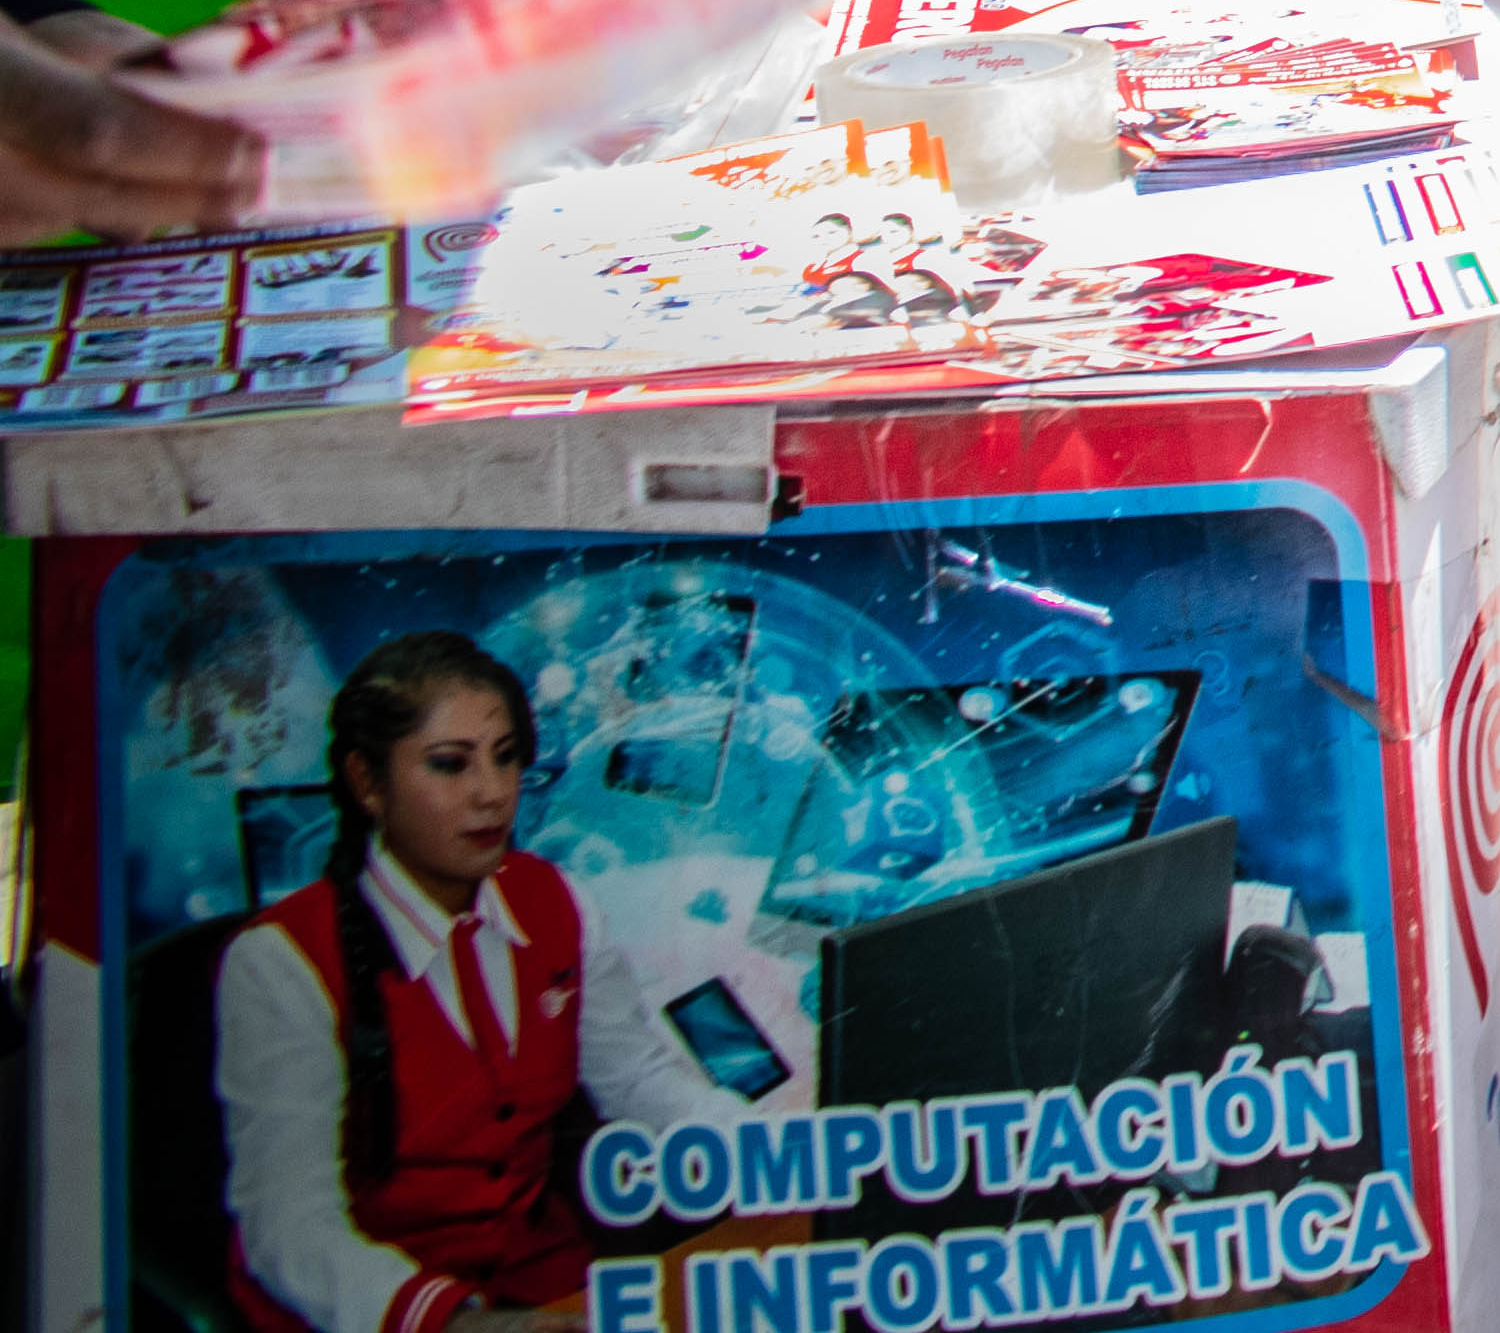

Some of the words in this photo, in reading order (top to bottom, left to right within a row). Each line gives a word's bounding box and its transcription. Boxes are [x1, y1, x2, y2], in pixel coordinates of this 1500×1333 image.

[583, 1043, 1364, 1227] COMPUTACIÓN
[588, 1260, 662, 1333] E
[686, 1171, 1432, 1333] INFORMÁTICA
